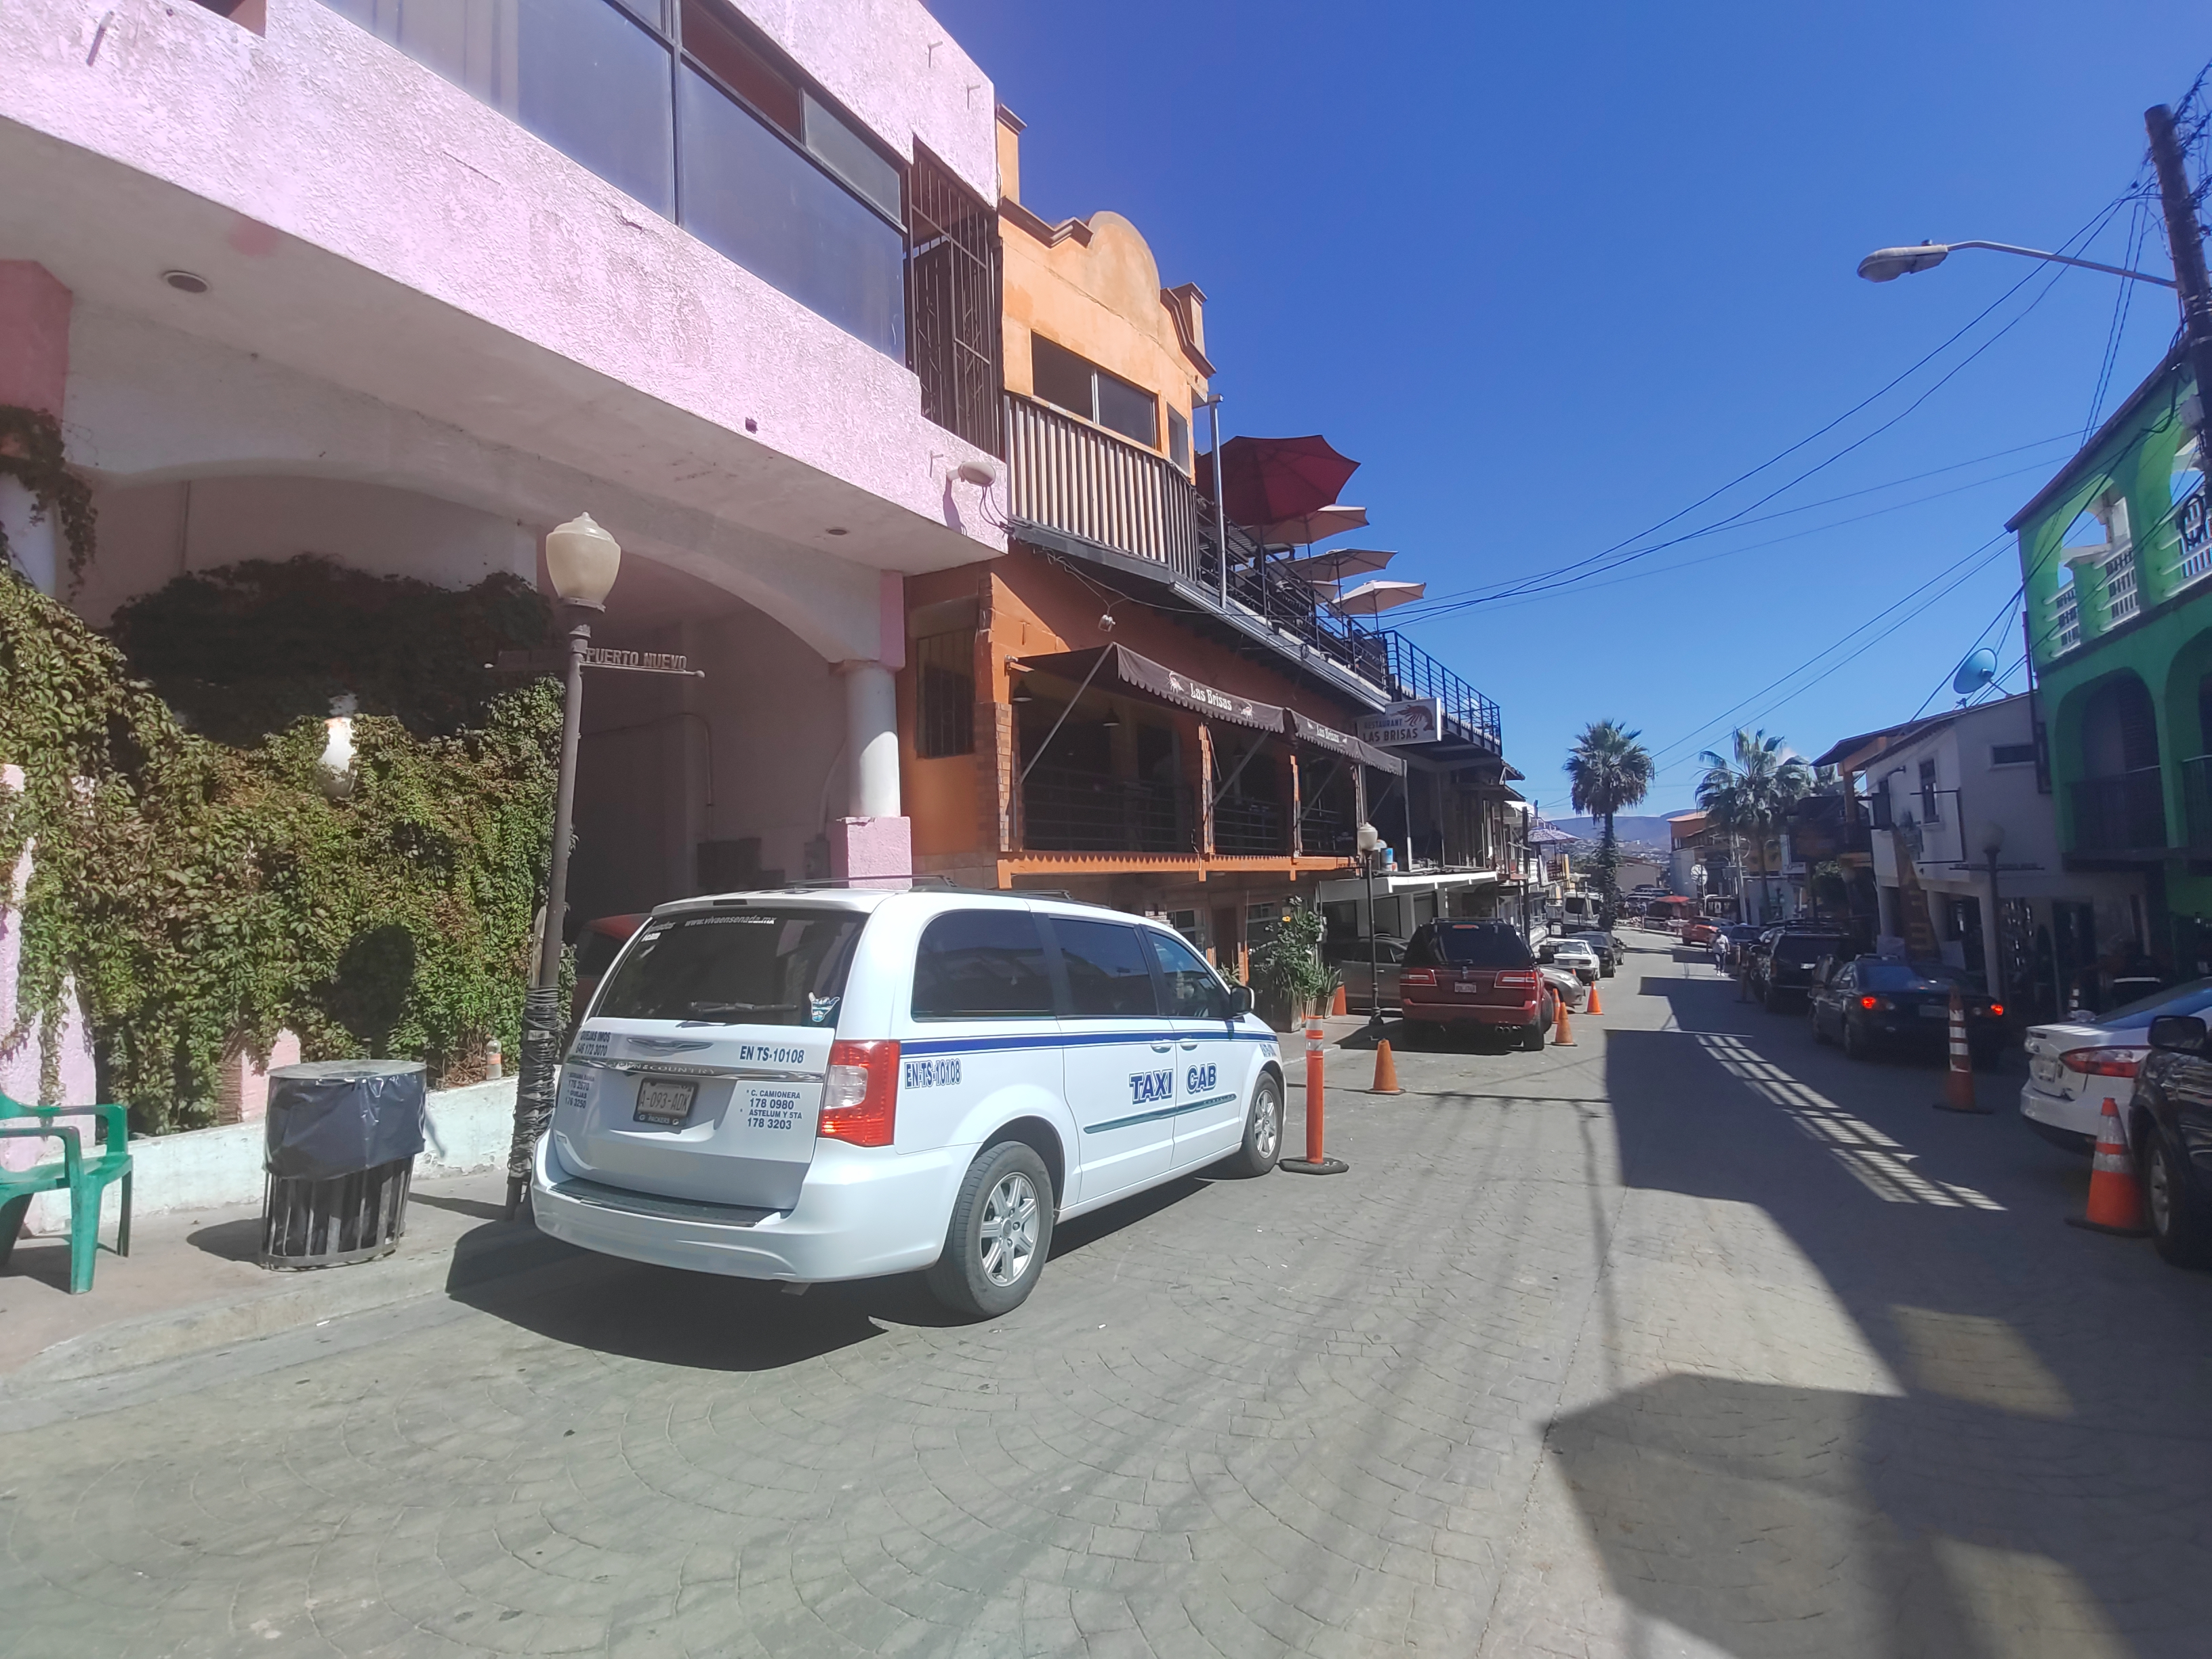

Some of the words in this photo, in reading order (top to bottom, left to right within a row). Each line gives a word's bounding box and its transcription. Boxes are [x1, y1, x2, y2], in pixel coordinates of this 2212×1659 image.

[587, 648, 638, 665] PUERTO
[644, 652, 687, 670] NUEVO
[1190, 683, 1206, 701] Las
[1206, 689, 1232, 711] Brisas
[1364, 719, 1402, 729] RESTAURANT
[1363, 731, 1380, 743] LAS
[1384, 729, 1418, 741] BRISAS
[739, 1046, 754, 1060] EN
[757, 1046, 804, 1063] TS-10108
[1129, 1069, 1173, 1105] TAXI
[1187, 1063, 1216, 1094] CAB
[760, 1090, 800, 1099] CAMIONERA
[750, 1098, 766, 1108] 178
[770, 1099, 794, 1109] 0980
[749, 1109, 780, 1118] ASTELUM
[747, 1118, 764, 1128] 178
[767, 1119, 792, 1130] 3203
